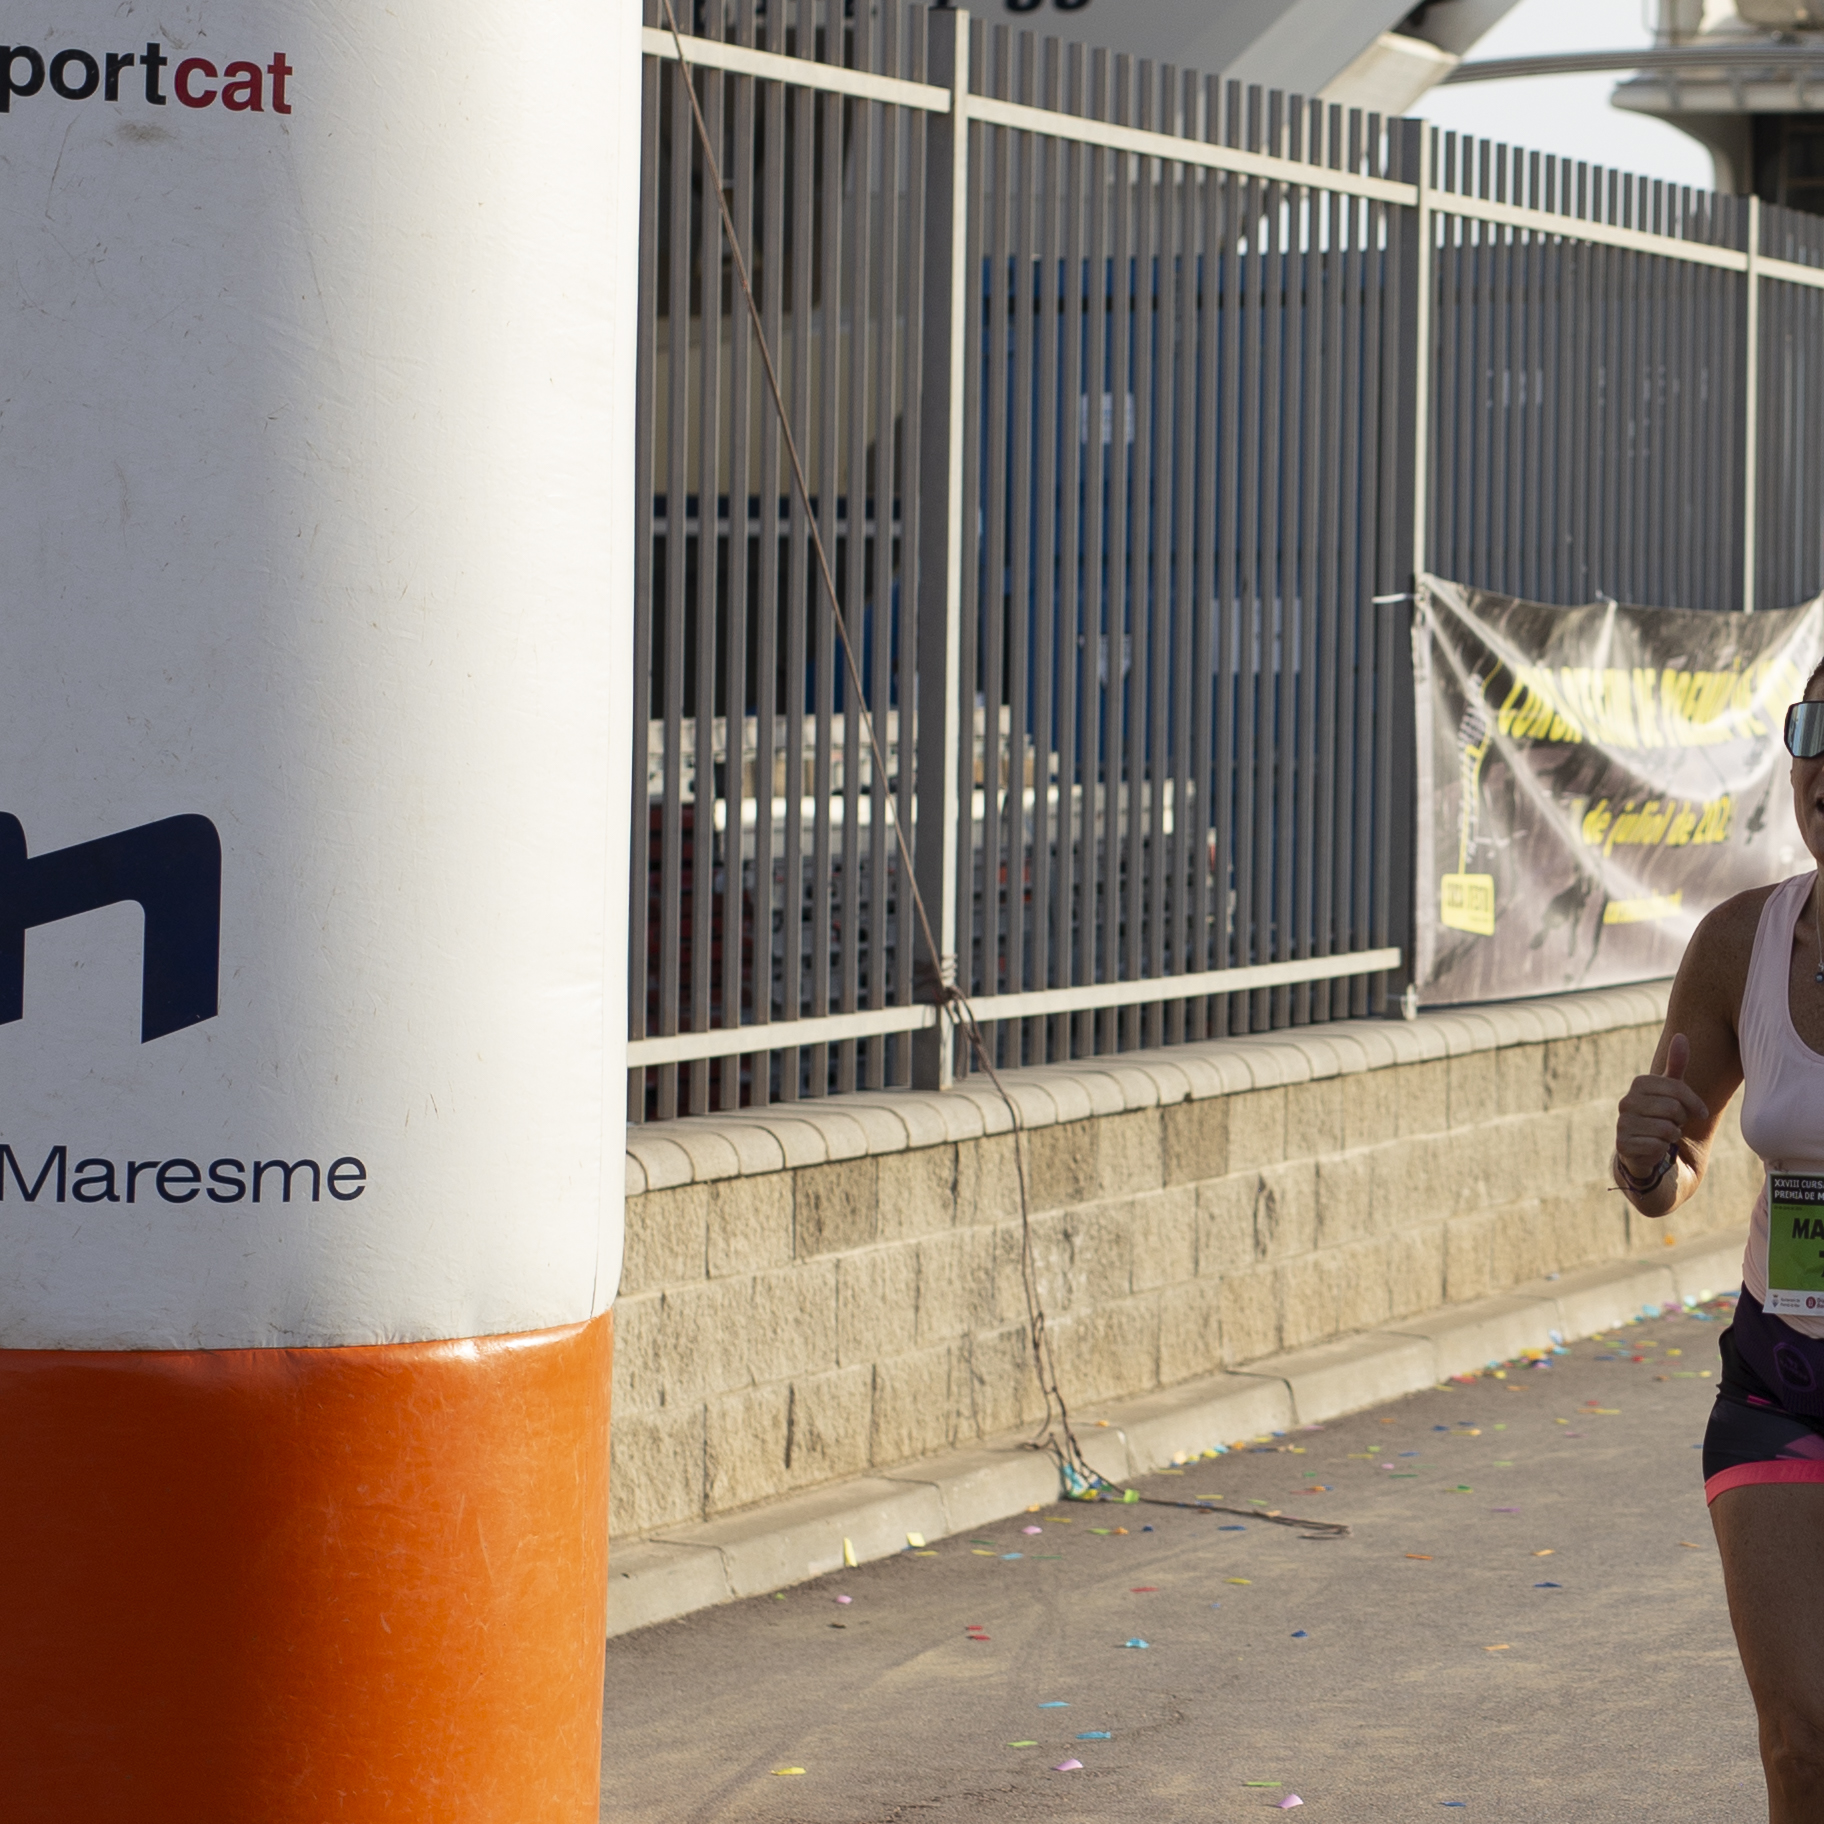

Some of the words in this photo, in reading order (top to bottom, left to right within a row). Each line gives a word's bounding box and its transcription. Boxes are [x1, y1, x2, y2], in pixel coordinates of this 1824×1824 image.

[0, 1143, 367, 1204] Maresme
[1774, 1178, 1800, 1189] XXVIII
[1804, 1191, 1815, 1200] DE
